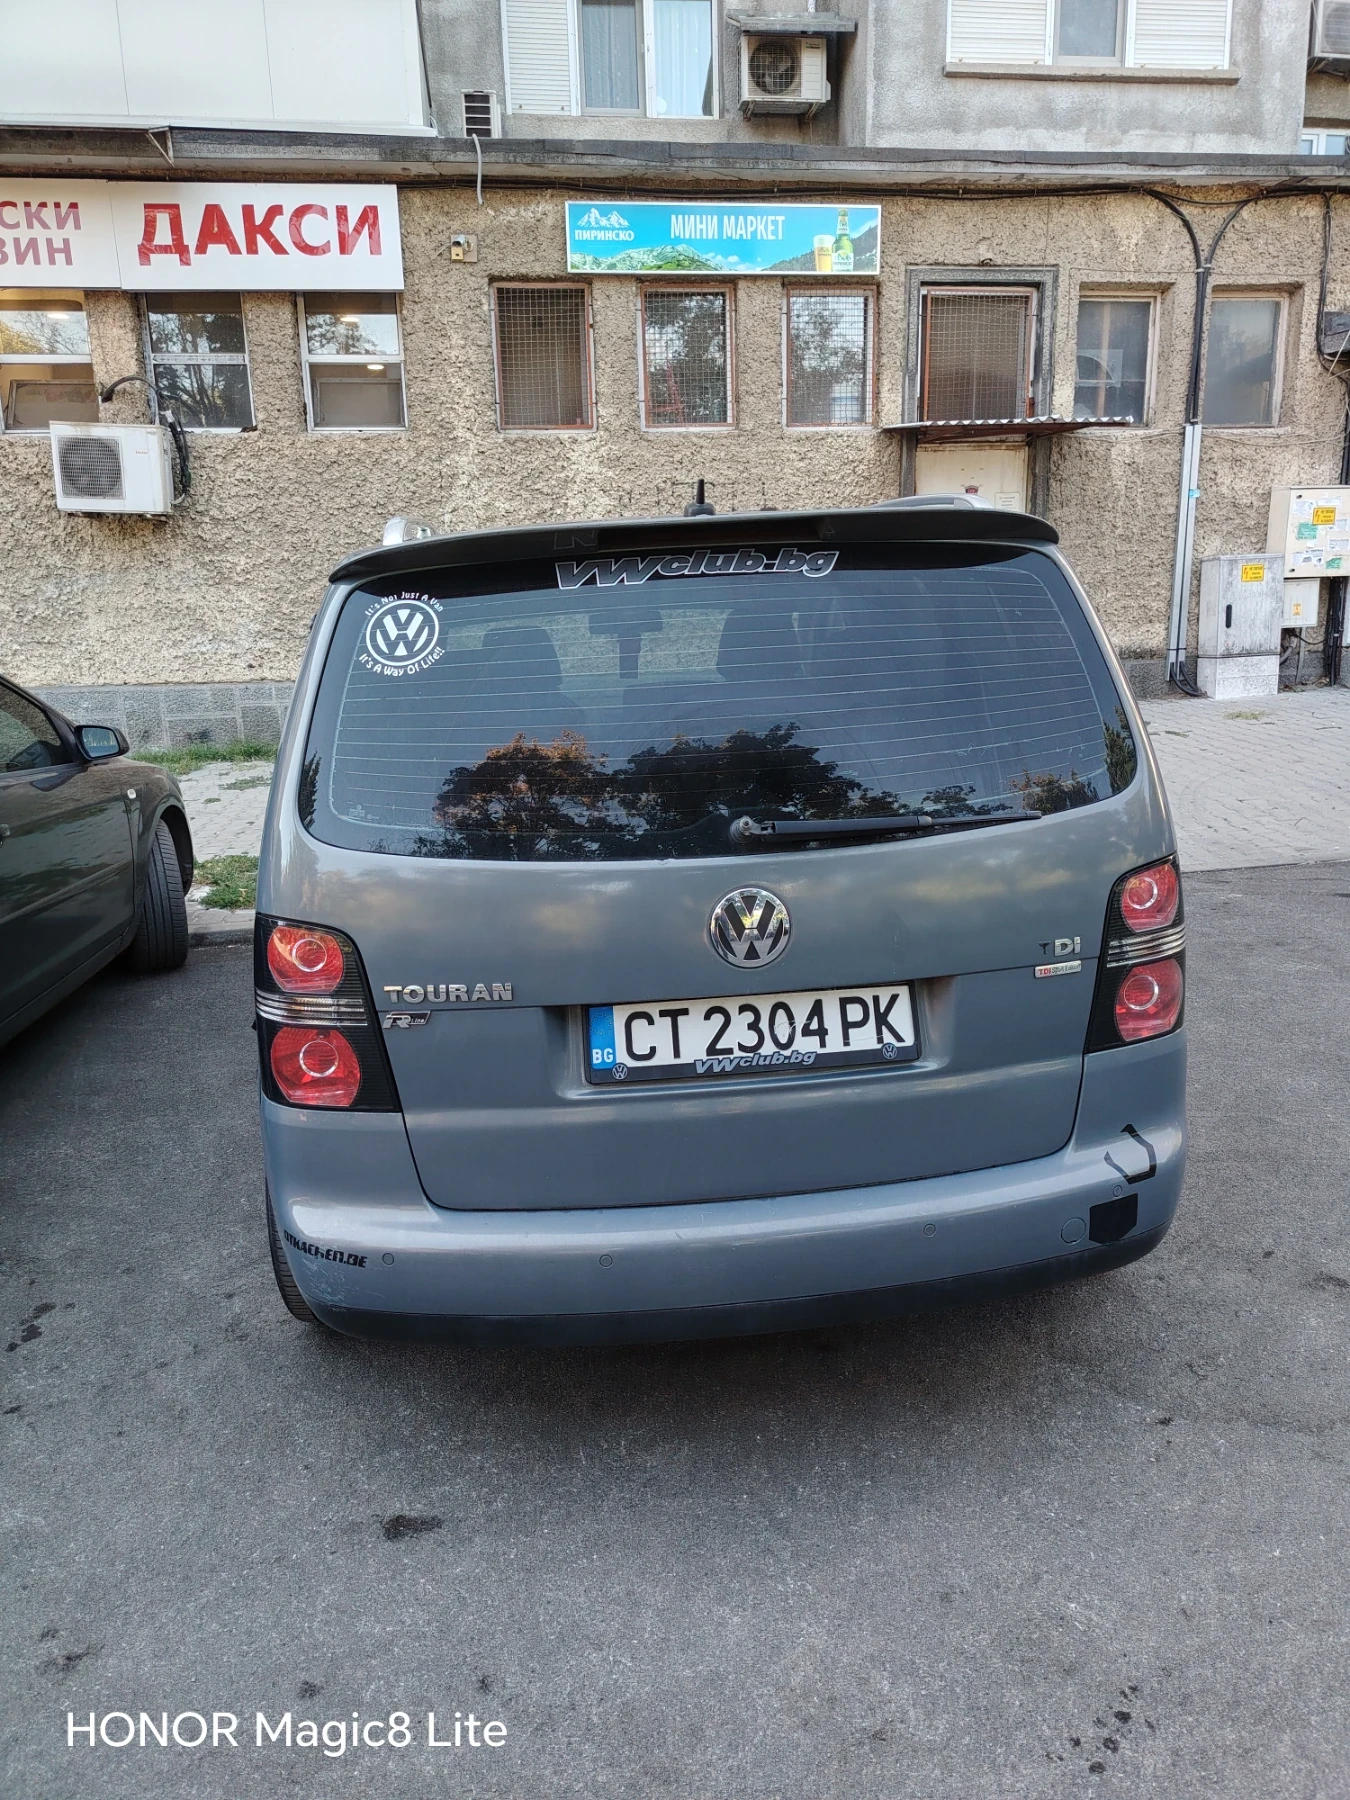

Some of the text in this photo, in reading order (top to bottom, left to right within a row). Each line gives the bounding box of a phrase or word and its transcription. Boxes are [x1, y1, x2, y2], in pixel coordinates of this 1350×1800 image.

[137, 203, 382, 266] ДАКСИ
[574, 229, 635, 241] ПИРИНСКО
[670, 214, 786, 240] МИНИ МАРКЕТ
[401, 591, 420, 599] Just
[430, 598, 444, 612] Van
[358, 653, 374, 669] It's
[373, 664, 382, 674] A
[383, 666, 404, 677] Way
[407, 663, 420, 675] Of
[383, 983, 513, 1004] TOURAN
[592, 1047, 614, 1064] BG
